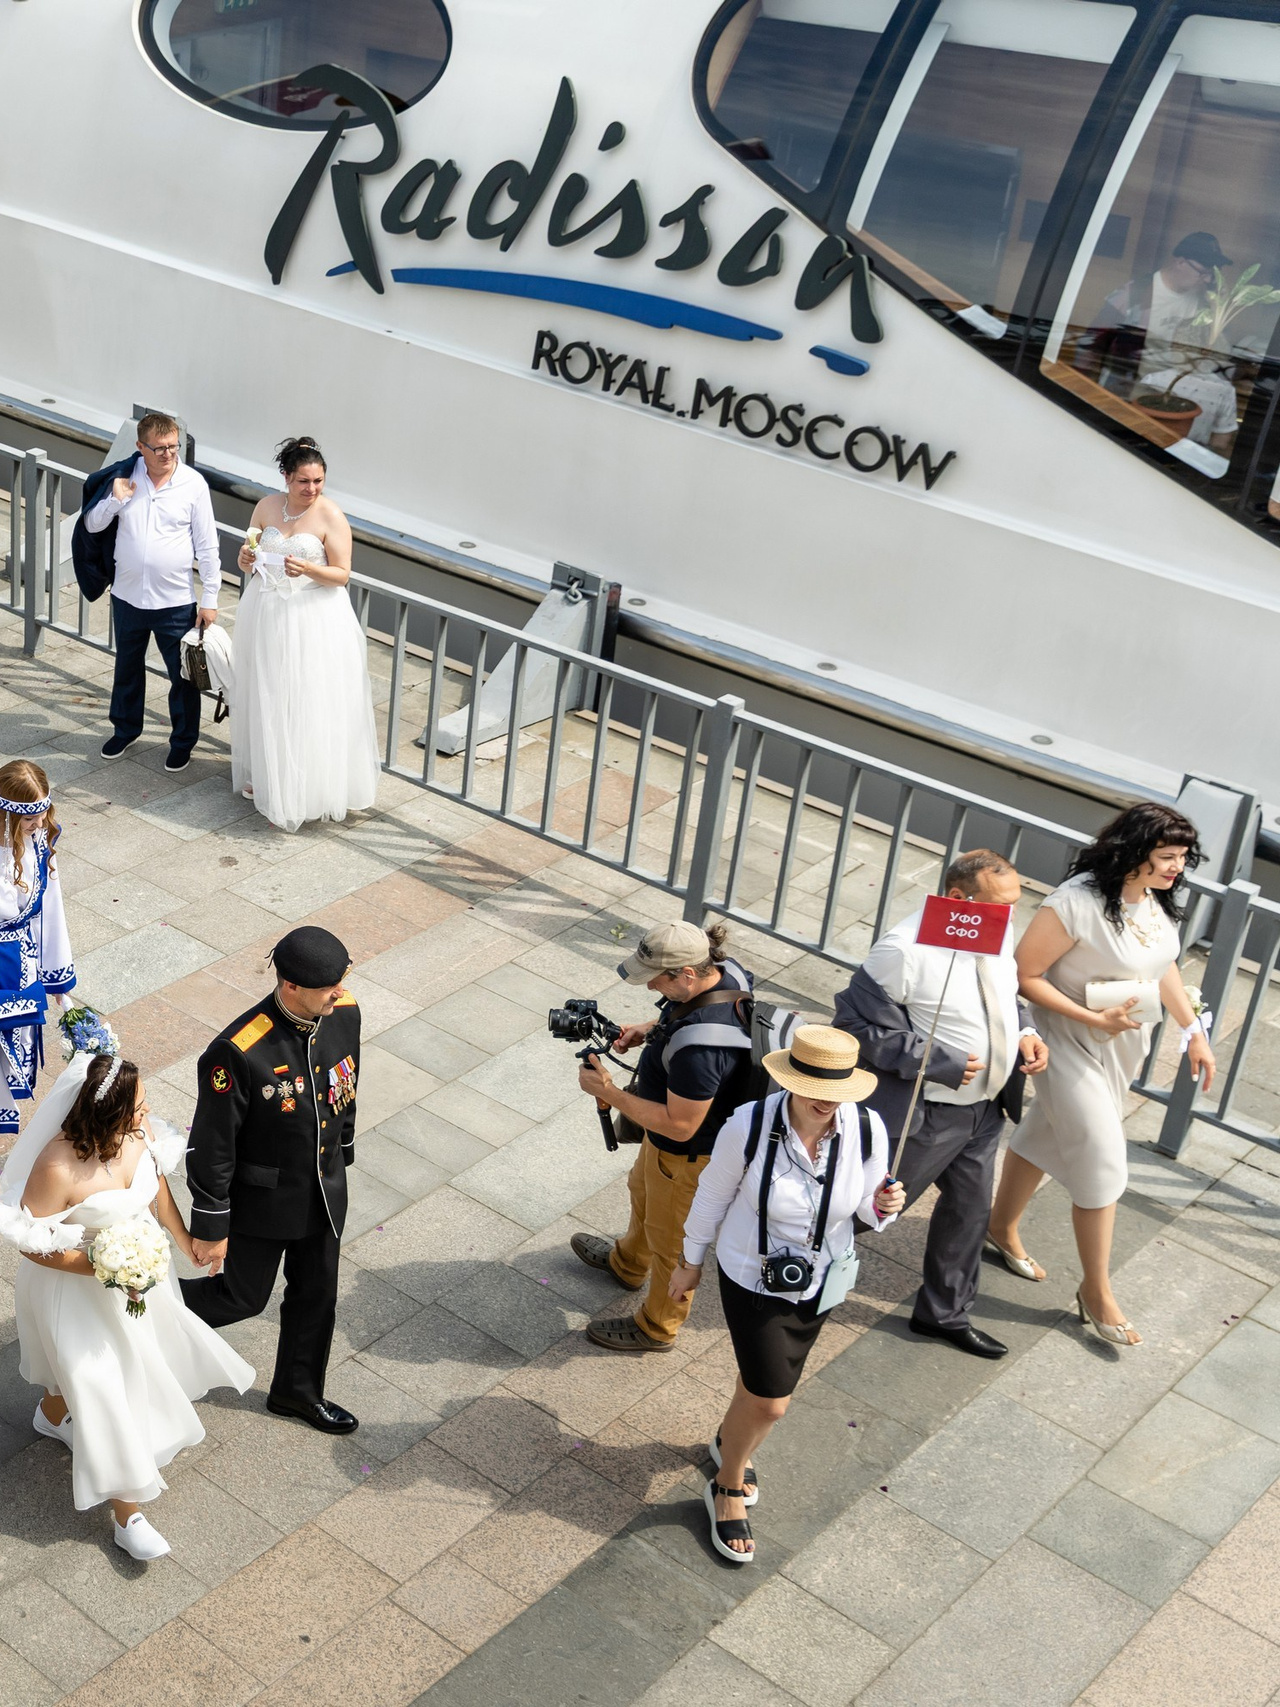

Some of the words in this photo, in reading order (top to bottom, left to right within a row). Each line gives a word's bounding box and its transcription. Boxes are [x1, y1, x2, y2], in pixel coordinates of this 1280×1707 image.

[264, 62, 885, 344] Radisson
[949, 911, 982, 926] УФО
[945, 925, 979, 939] СФО
